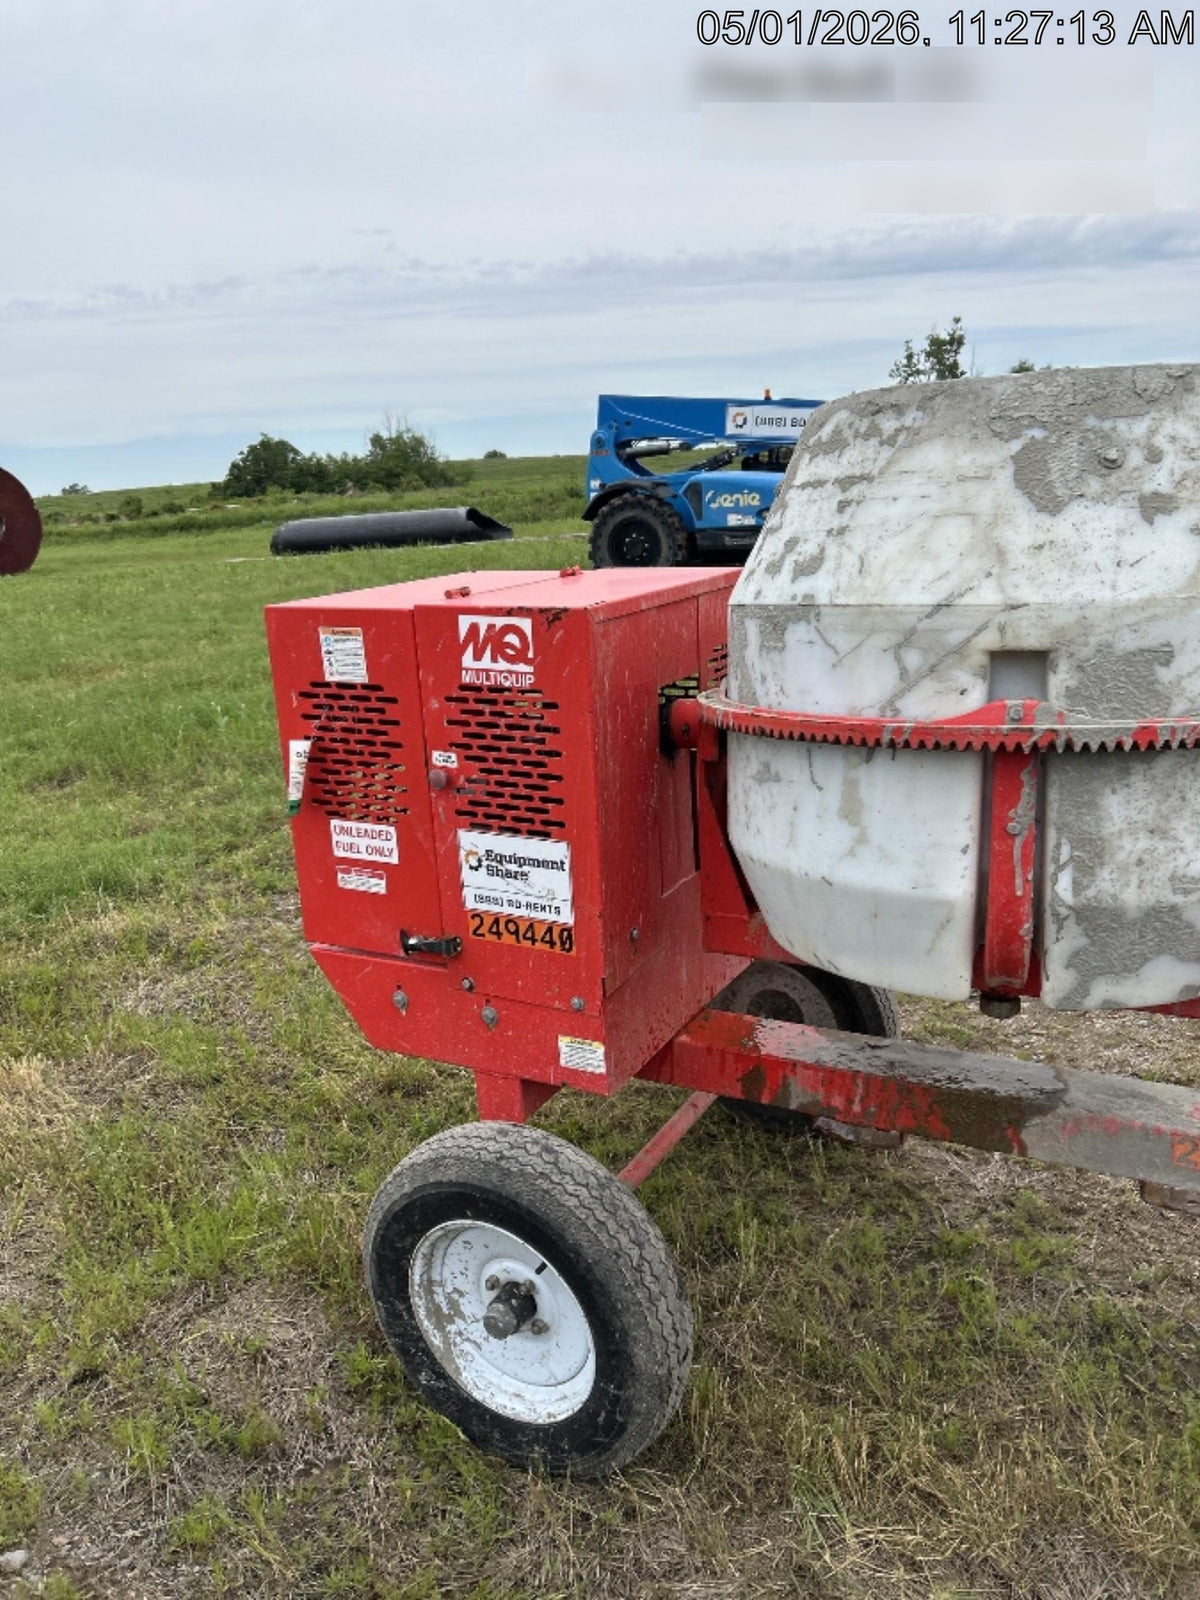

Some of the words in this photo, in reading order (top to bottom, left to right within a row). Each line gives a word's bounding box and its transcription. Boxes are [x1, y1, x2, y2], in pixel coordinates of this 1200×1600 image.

[705, 489, 761, 509] Genie
[460, 621, 534, 666] MQ
[461, 669, 535, 688] MULTIQUIP
[333, 824, 394, 842] UNLEADED
[335, 840, 363, 854] FUEL
[365, 844, 394, 858] ONLY
[484, 849, 567, 872] Equipment
[486, 864, 530, 881] Share
[470, 913, 574, 954] 249440
